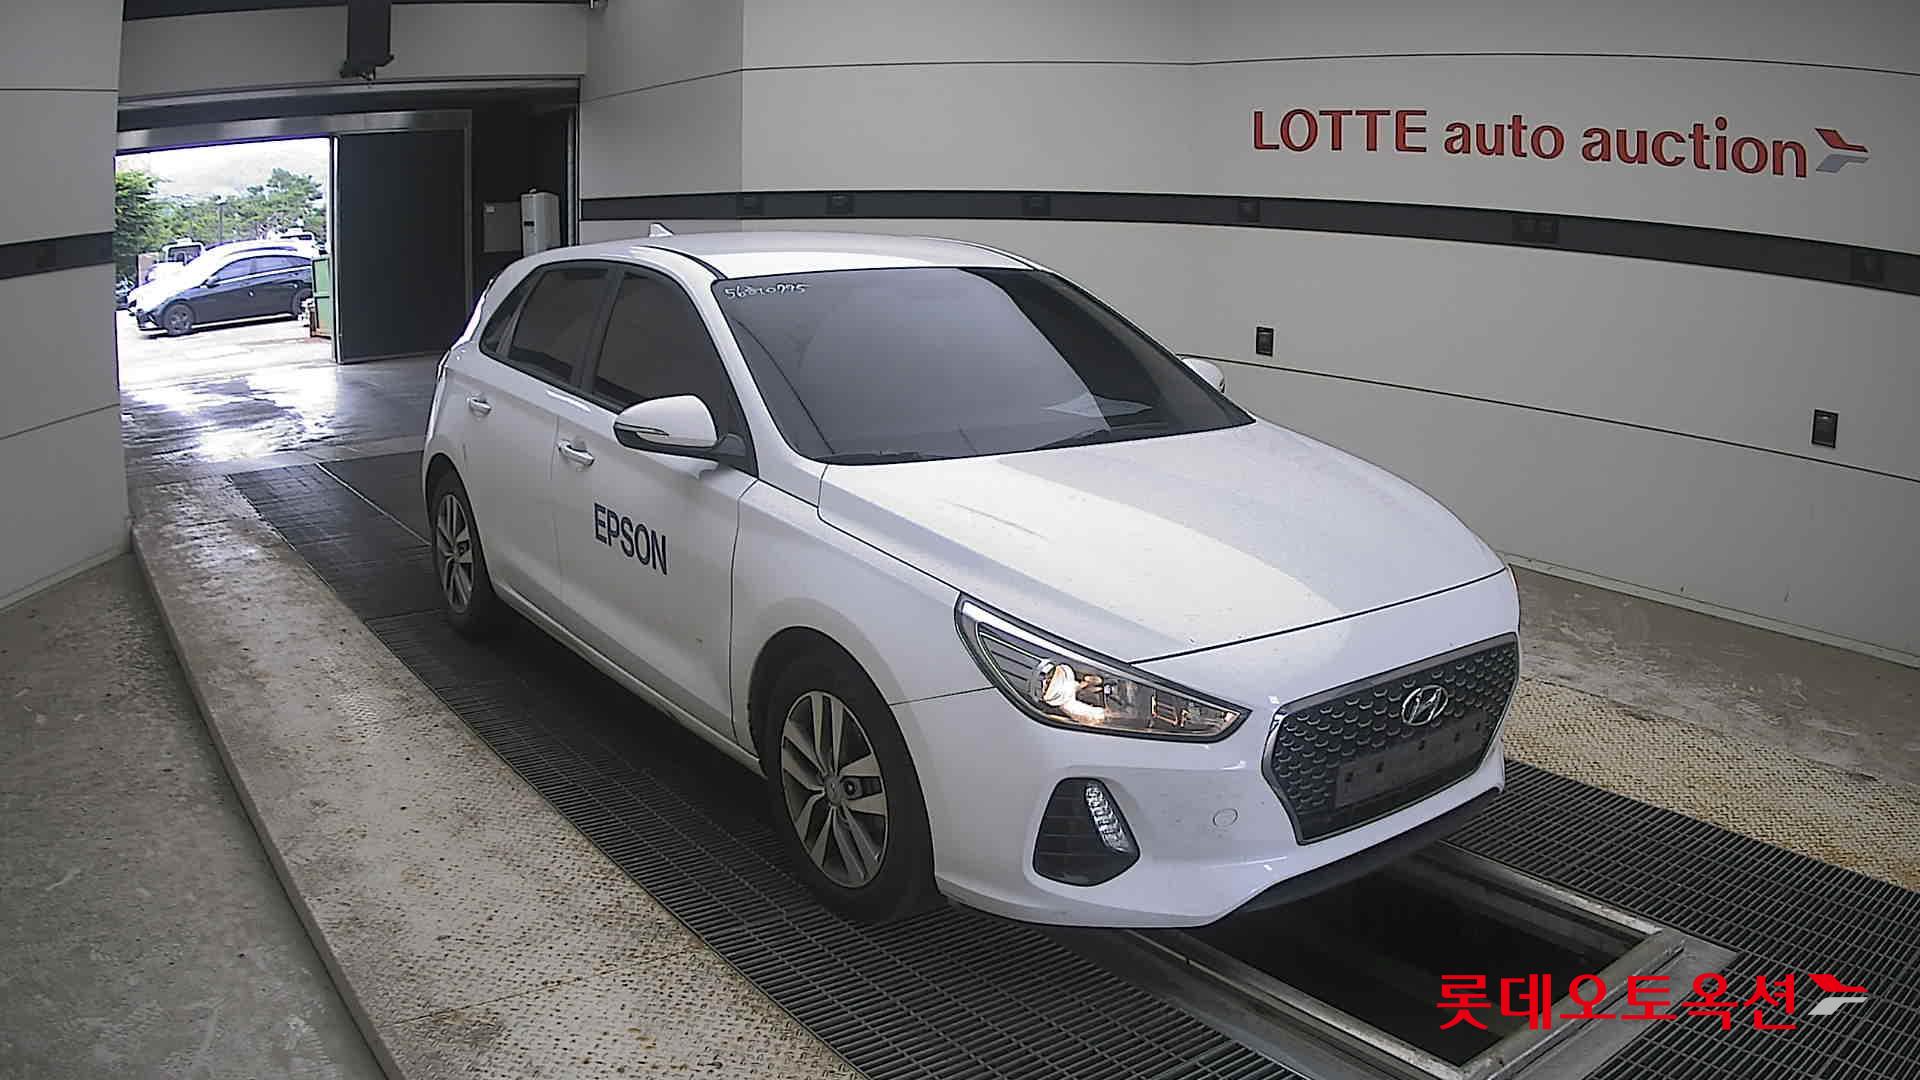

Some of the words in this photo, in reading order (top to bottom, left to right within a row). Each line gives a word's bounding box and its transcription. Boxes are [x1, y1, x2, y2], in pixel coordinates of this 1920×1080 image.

[1253, 109, 1427, 153] LOTTE
[1444, 114, 1566, 160] auto
[1581, 117, 1808, 178] auction
[594, 502, 667, 576] EPSON
